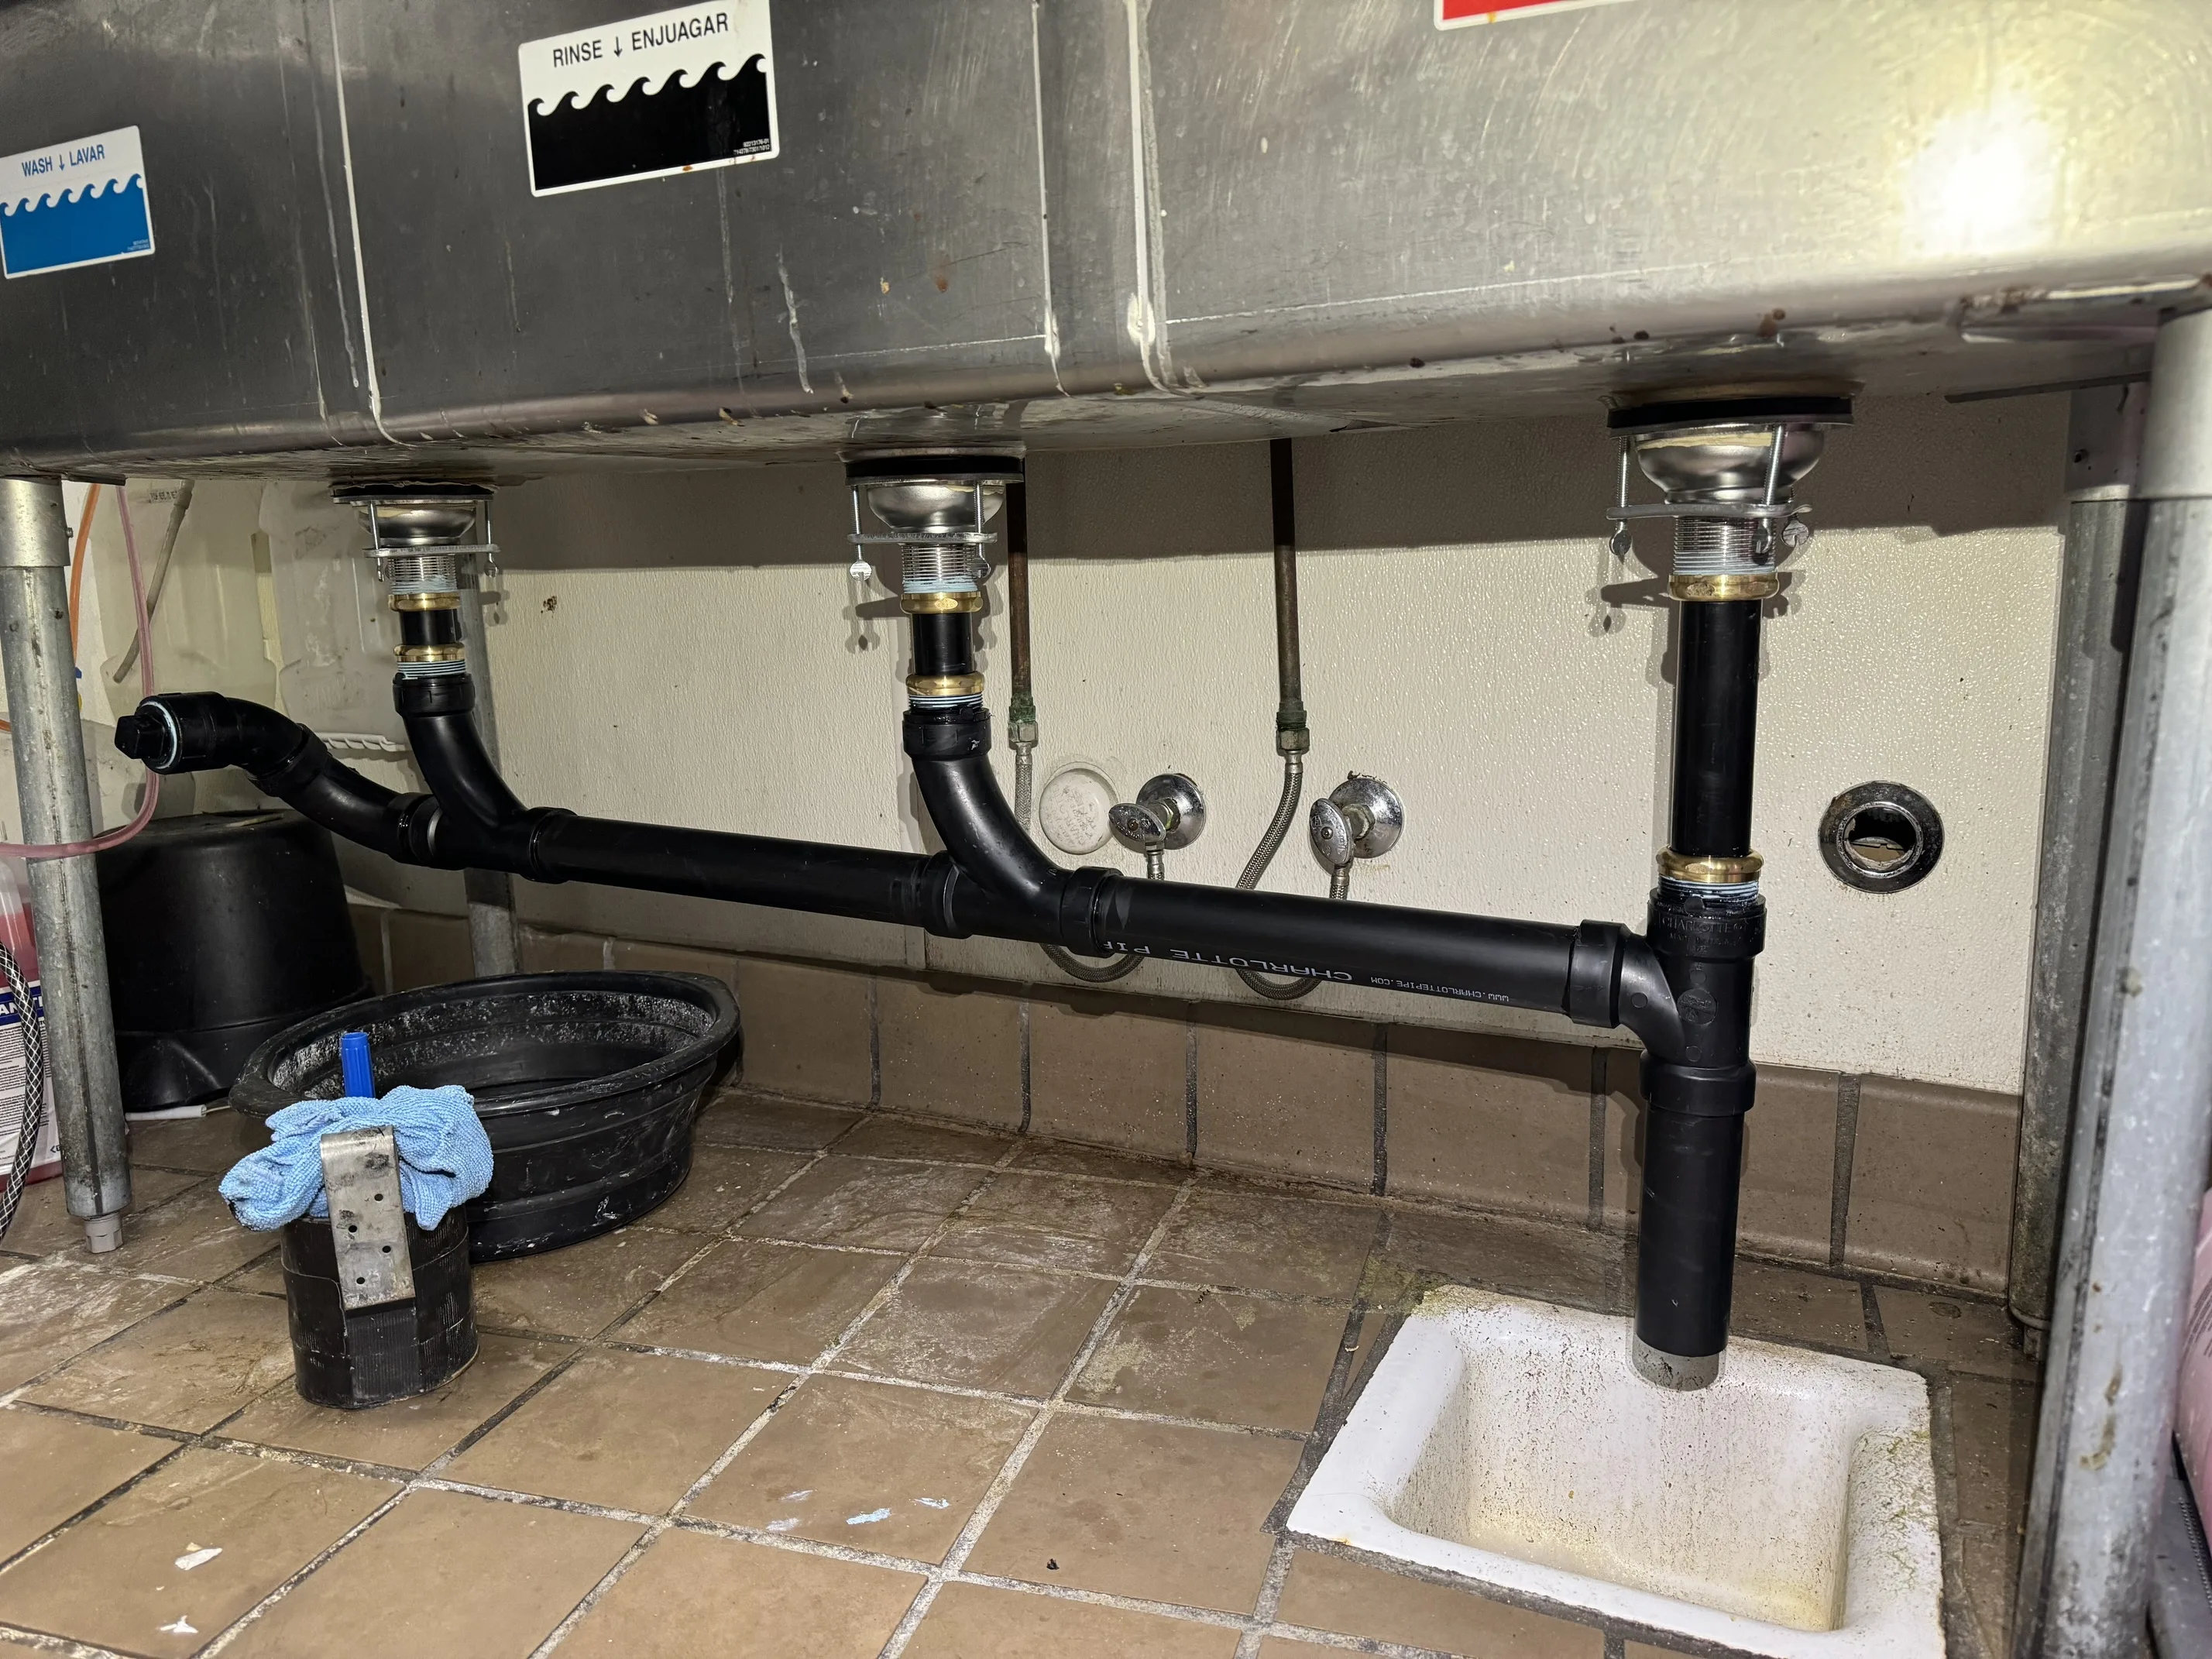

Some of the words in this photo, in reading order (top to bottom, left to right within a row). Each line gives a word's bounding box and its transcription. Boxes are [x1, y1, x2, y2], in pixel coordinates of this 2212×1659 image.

[553, 40, 603, 67] RINSE
[631, 12, 729, 50] ENJUAGAR
[22, 156, 53, 177] WASH
[69, 144, 105, 167] LAVAR
[1170, 949, 1353, 981] CHARLOTTE
[1371, 977, 1509, 1001] WWW.CHARLOTTEPIPE.COM
